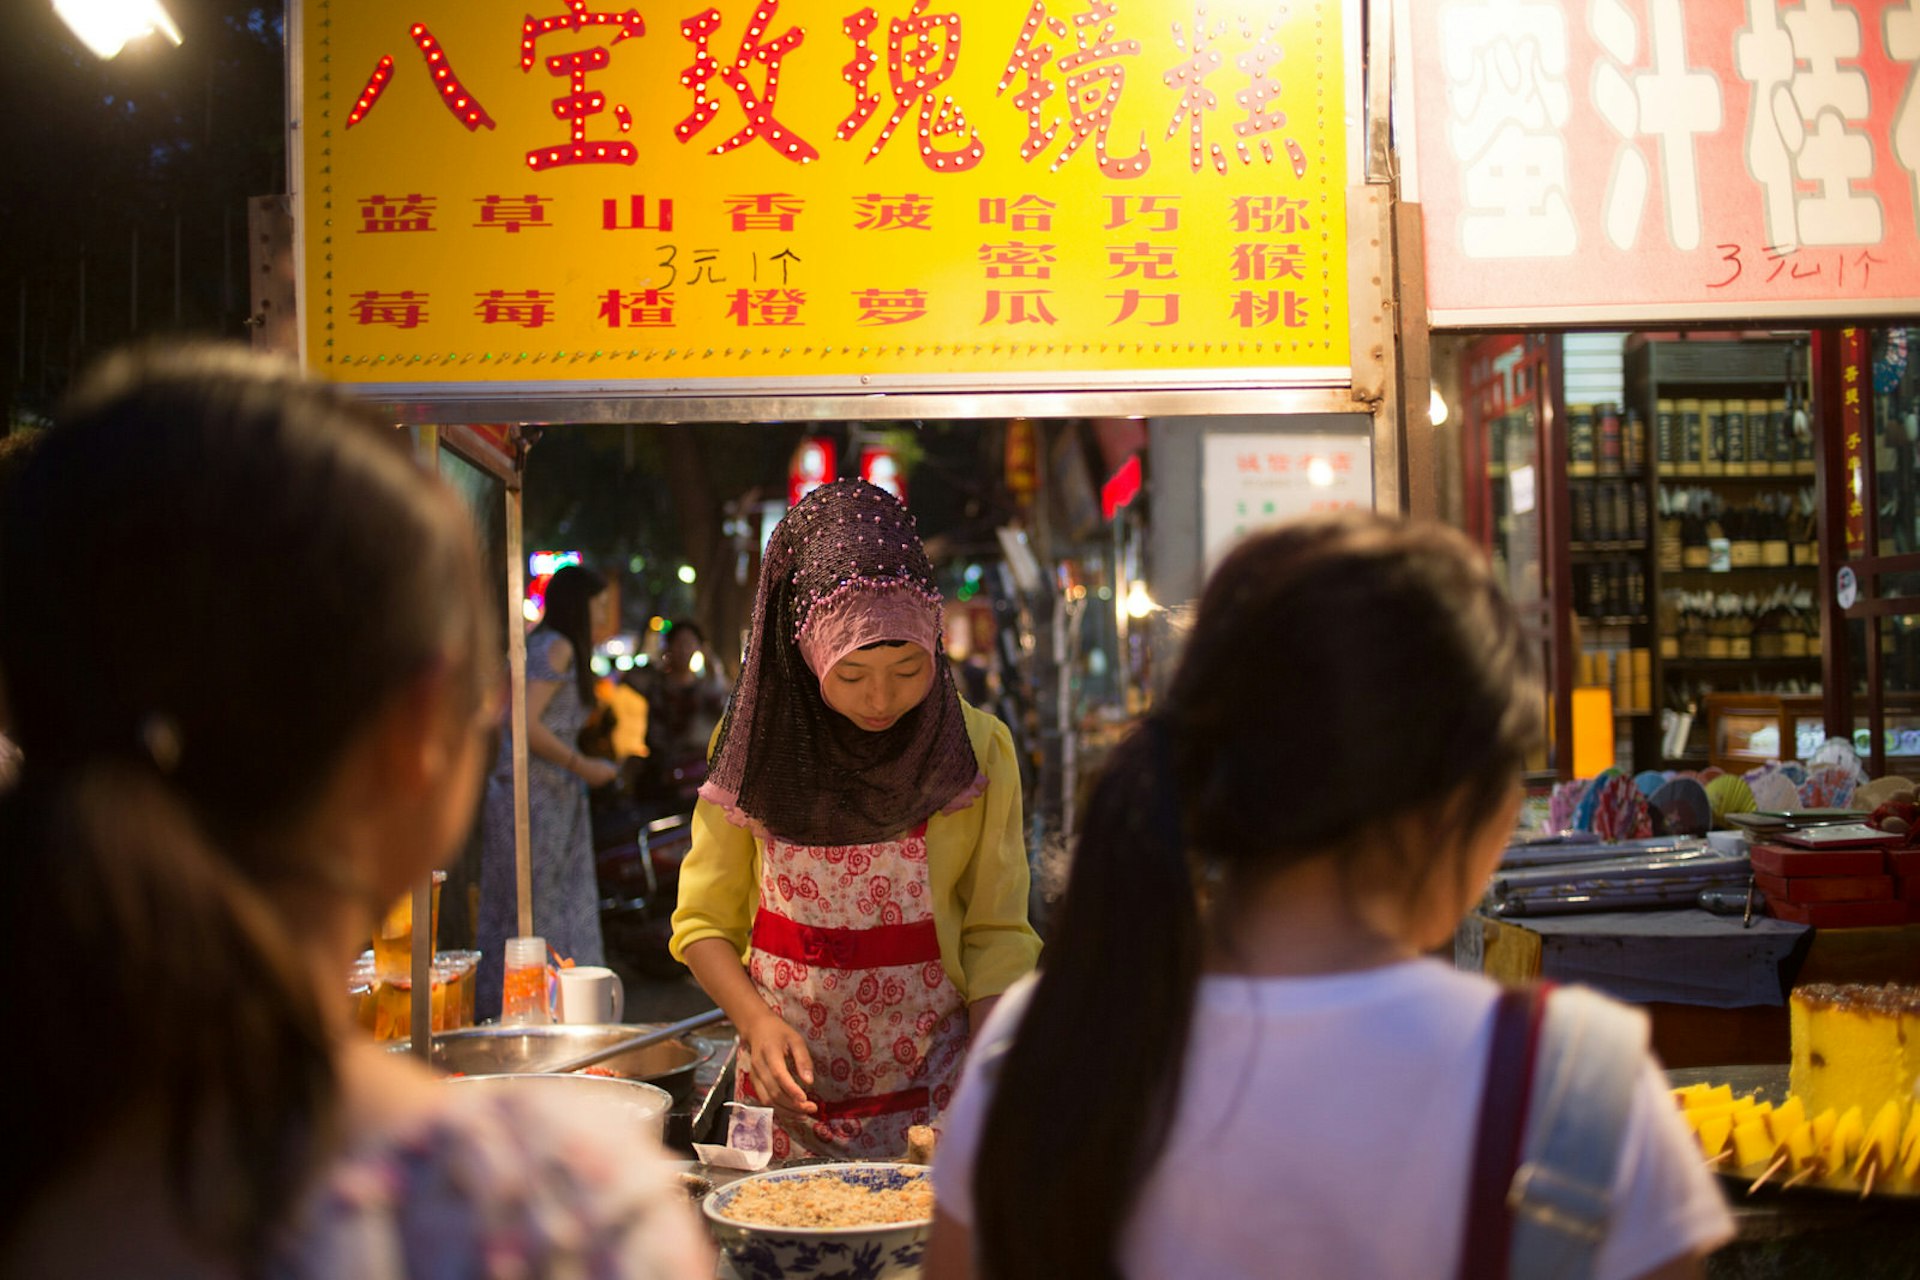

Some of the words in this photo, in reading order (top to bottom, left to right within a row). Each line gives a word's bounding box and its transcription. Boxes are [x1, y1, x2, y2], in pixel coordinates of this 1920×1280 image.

[346, 0, 1308, 179] 八宝玫瑰镜糕
[978, 194, 1058, 327] 哈密瓜
[1104, 194, 1182, 328] 巧克力
